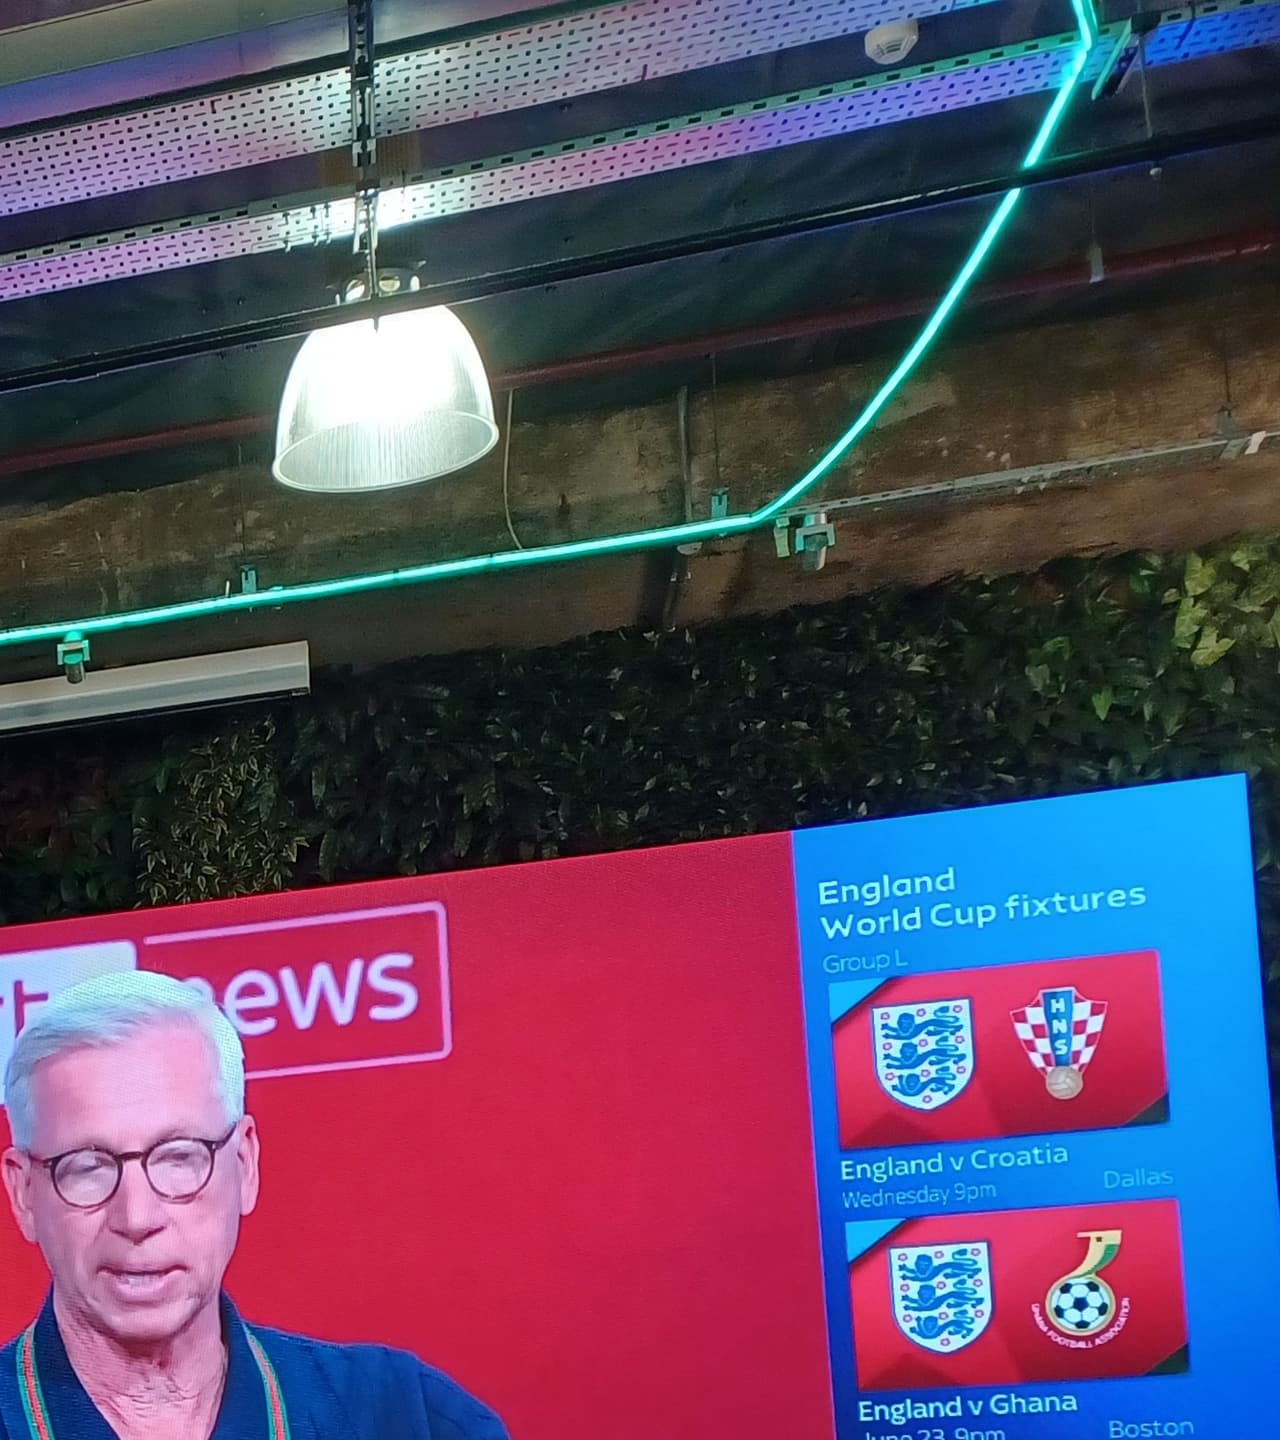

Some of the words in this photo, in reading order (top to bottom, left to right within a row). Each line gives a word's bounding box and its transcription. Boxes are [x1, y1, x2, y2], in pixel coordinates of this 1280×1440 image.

[818, 867, 956, 907] England
[821, 906, 922, 939] World
[930, 900, 997, 928] Cup
[1005, 886, 1147, 918] fixtures
[823, 951, 890, 975] Group
[894, 949, 909, 966] L
[180, 951, 419, 1036] ews
[841, 1153, 943, 1183] England
[948, 1156, 964, 1172] v
[970, 1143, 1069, 1171] Croatia
[1103, 1167, 1174, 1189] Dallas
[842, 1185, 951, 1208] Wednesday
[953, 1182, 996, 1204] 9pm
[858, 1398, 963, 1426] England
[968, 1402, 983, 1416] v
[990, 1392, 1078, 1414] Ghana
[1109, 1419, 1194, 1439] Boston
